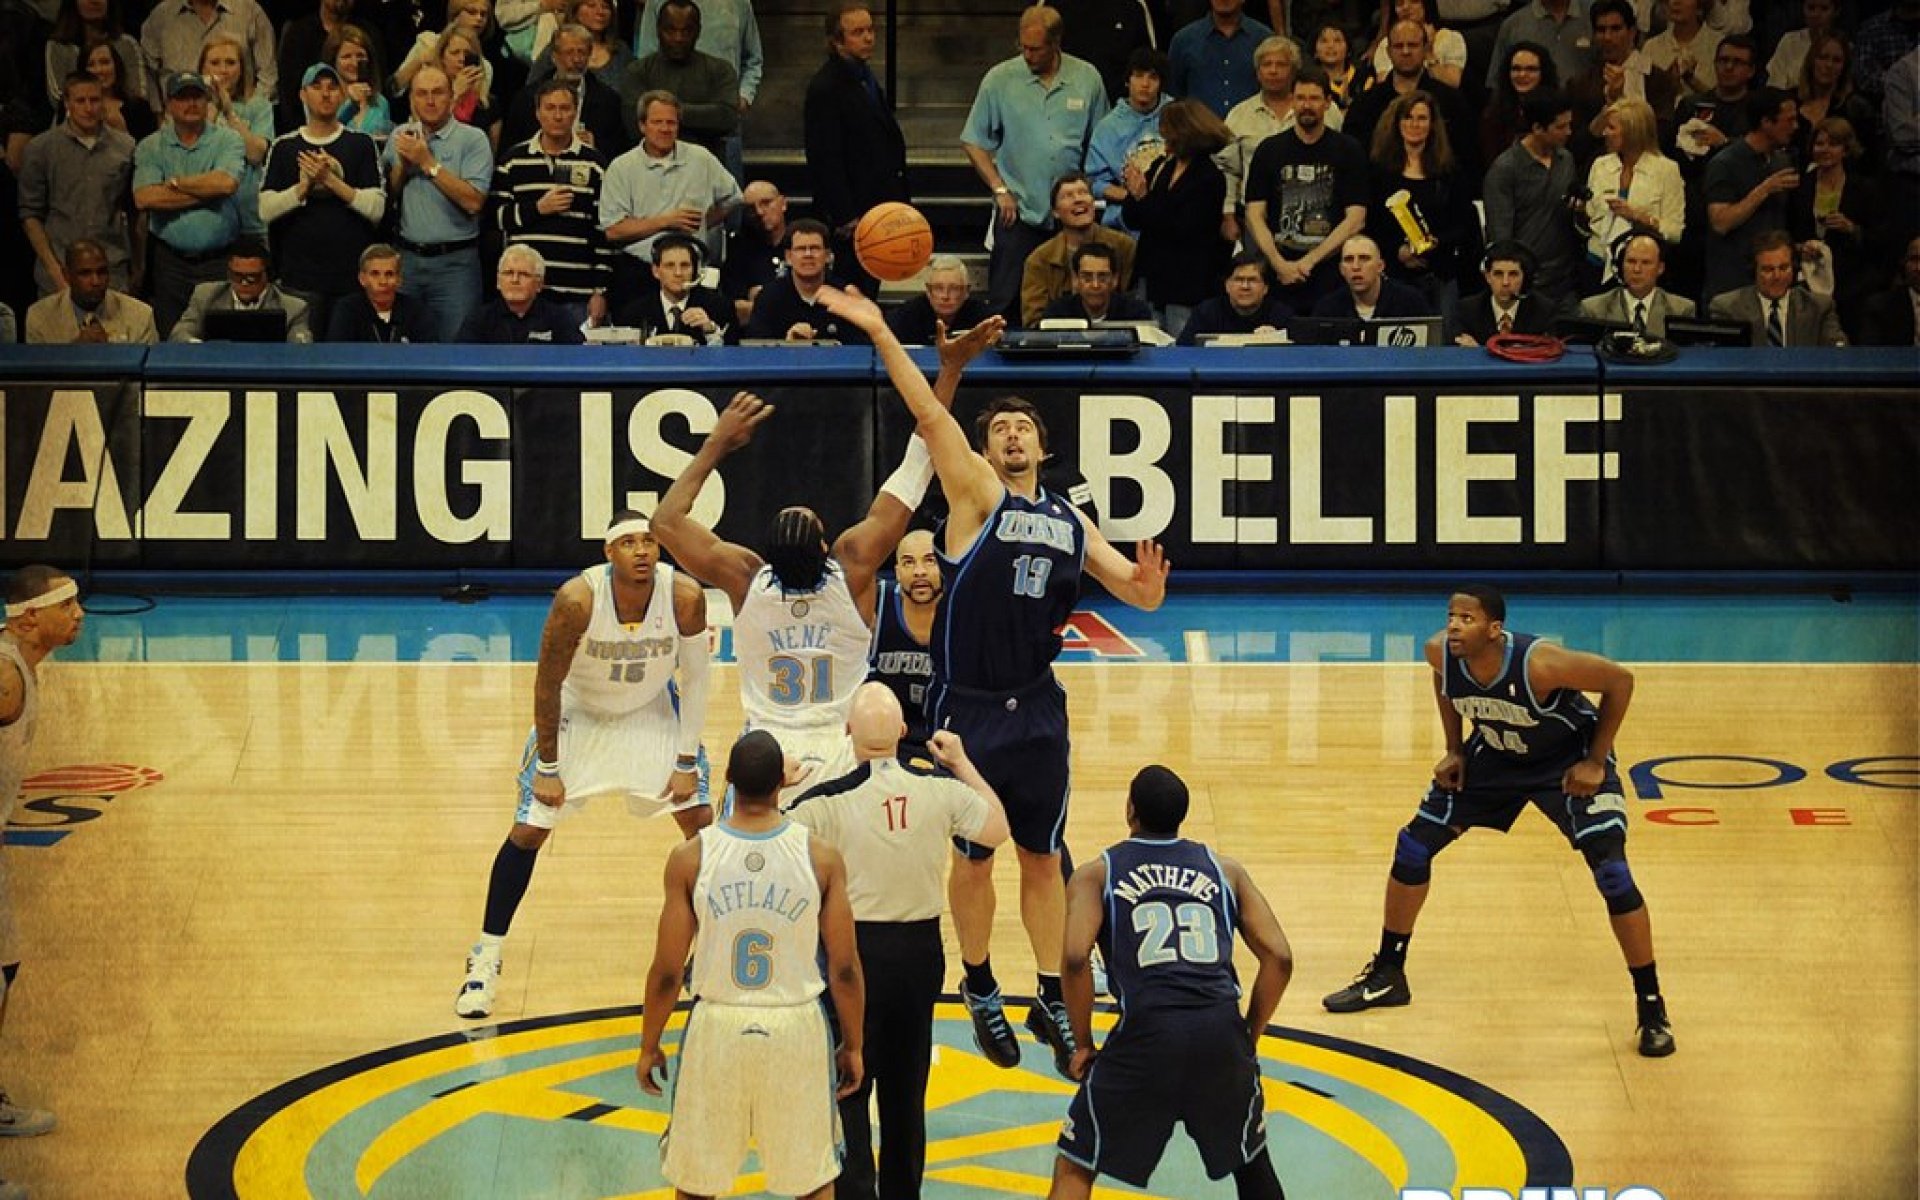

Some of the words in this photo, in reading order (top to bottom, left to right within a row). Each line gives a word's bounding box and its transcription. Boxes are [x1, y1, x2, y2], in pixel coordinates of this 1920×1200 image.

[0, 389, 512, 542] AZING
[580, 389, 726, 542] IS
[1079, 394, 1622, 543] BELIEF
[1012, 554, 1053, 598] 13
[609, 661, 646, 683] 15
[767, 655, 834, 705] 31
[882, 796, 910, 832] 17
[707, 880, 809, 923] AFFLALO
[1113, 864, 1222, 905] MATTHEWS
[1131, 901, 1220, 969] 23
[731, 928, 774, 990] 6
